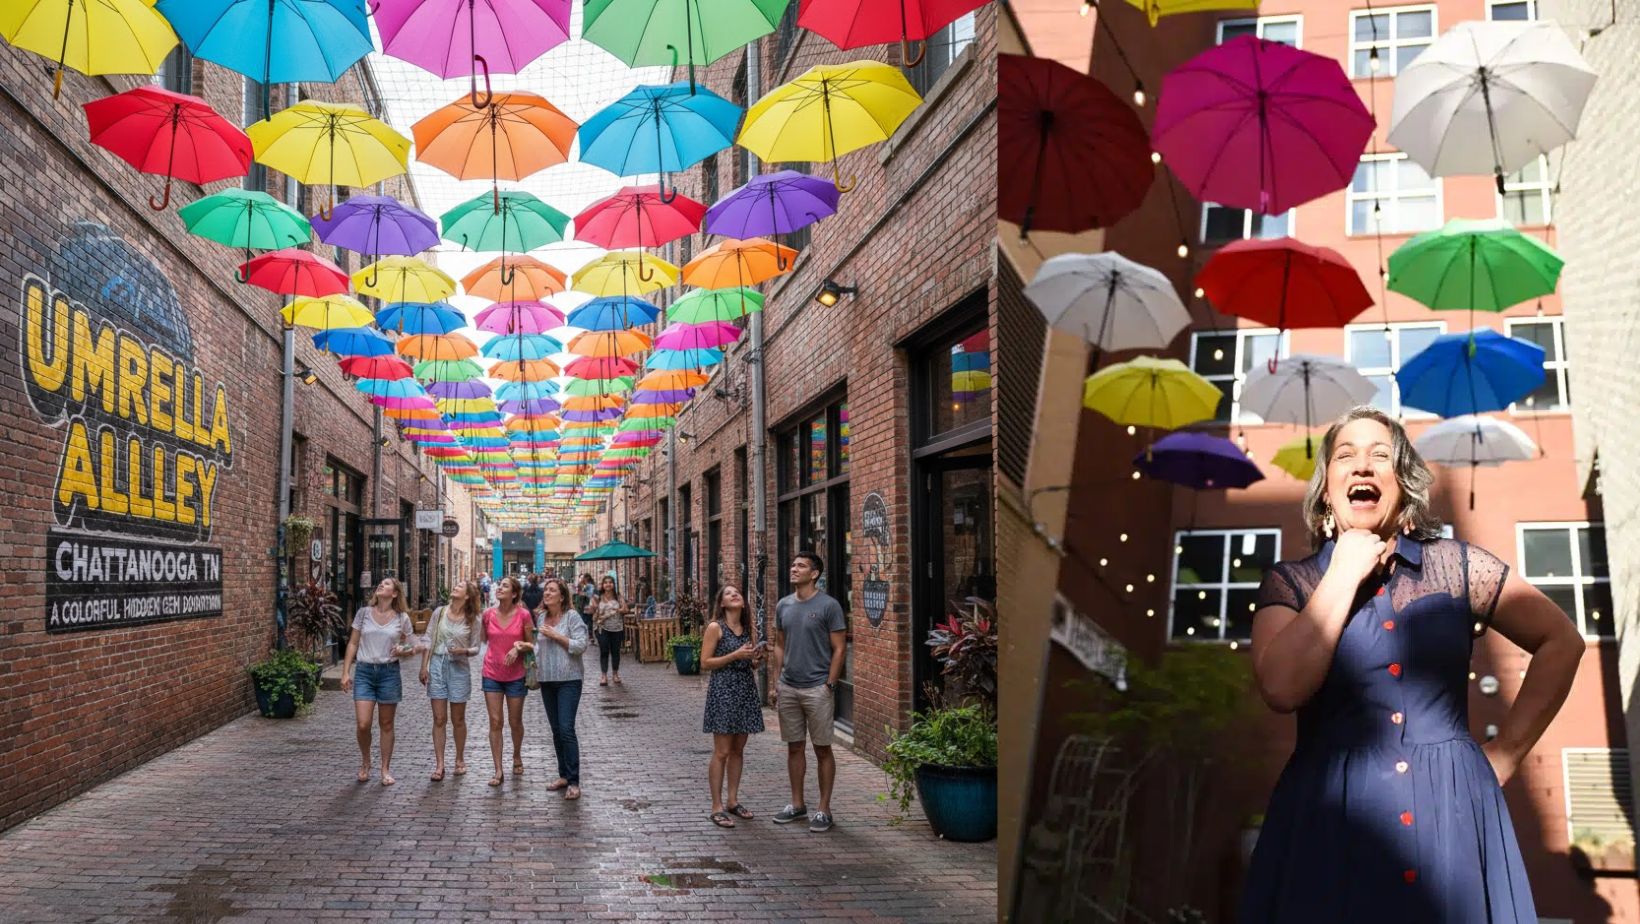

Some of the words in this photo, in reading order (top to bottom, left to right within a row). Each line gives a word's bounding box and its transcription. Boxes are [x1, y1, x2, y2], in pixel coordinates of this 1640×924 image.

[26, 285, 231, 455] UMRELLA
[58, 422, 217, 528] ALLLEY
[55, 541, 198, 582] CHATTANOOGA
[201, 552, 219, 582] TN
[50, 600, 60, 626] A
[61, 598, 121, 624] COLORFUL
